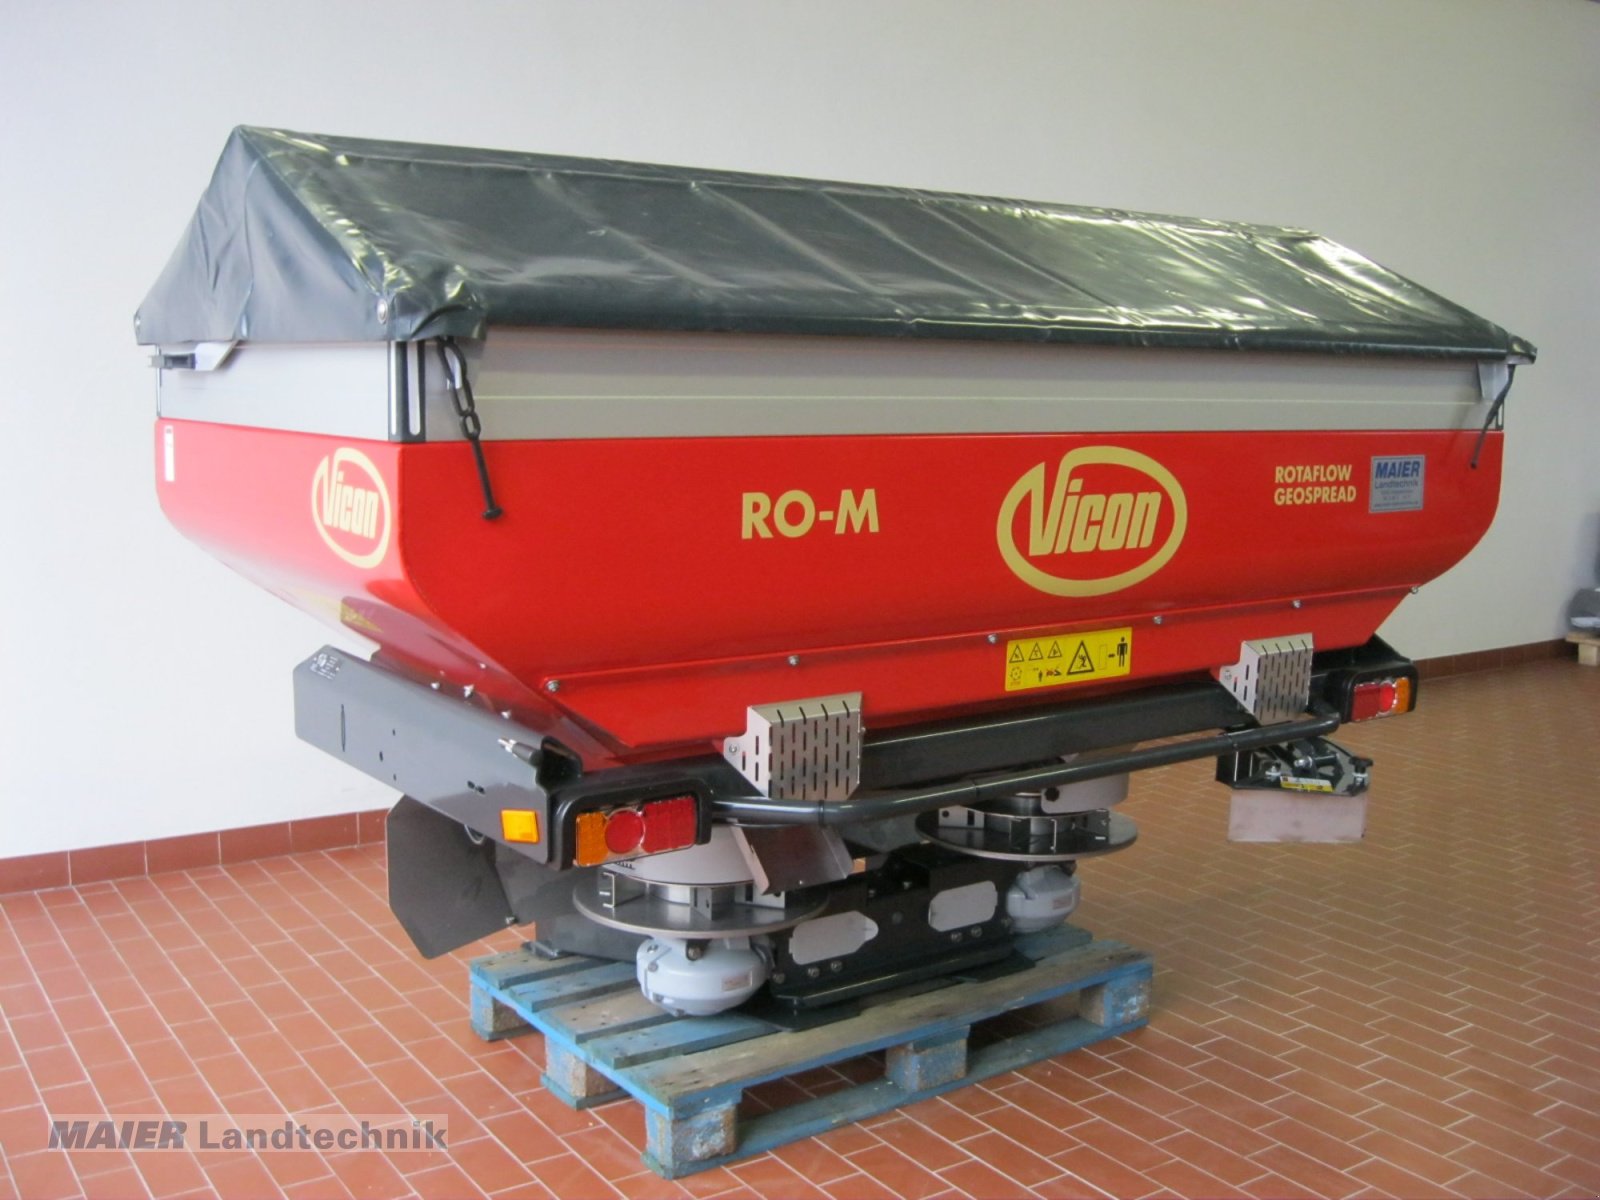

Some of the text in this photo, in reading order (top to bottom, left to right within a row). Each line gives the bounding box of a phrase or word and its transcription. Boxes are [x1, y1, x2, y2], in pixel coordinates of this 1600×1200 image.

[1274, 464, 1353, 484] ROTAFLOW
[1374, 460, 1421, 479] MAIER
[320, 447, 380, 541] Vicon
[1022, 447, 1166, 558] Vicon
[1273, 485, 1358, 506] GEOSPREAD
[741, 488, 880, 540] RO-M
